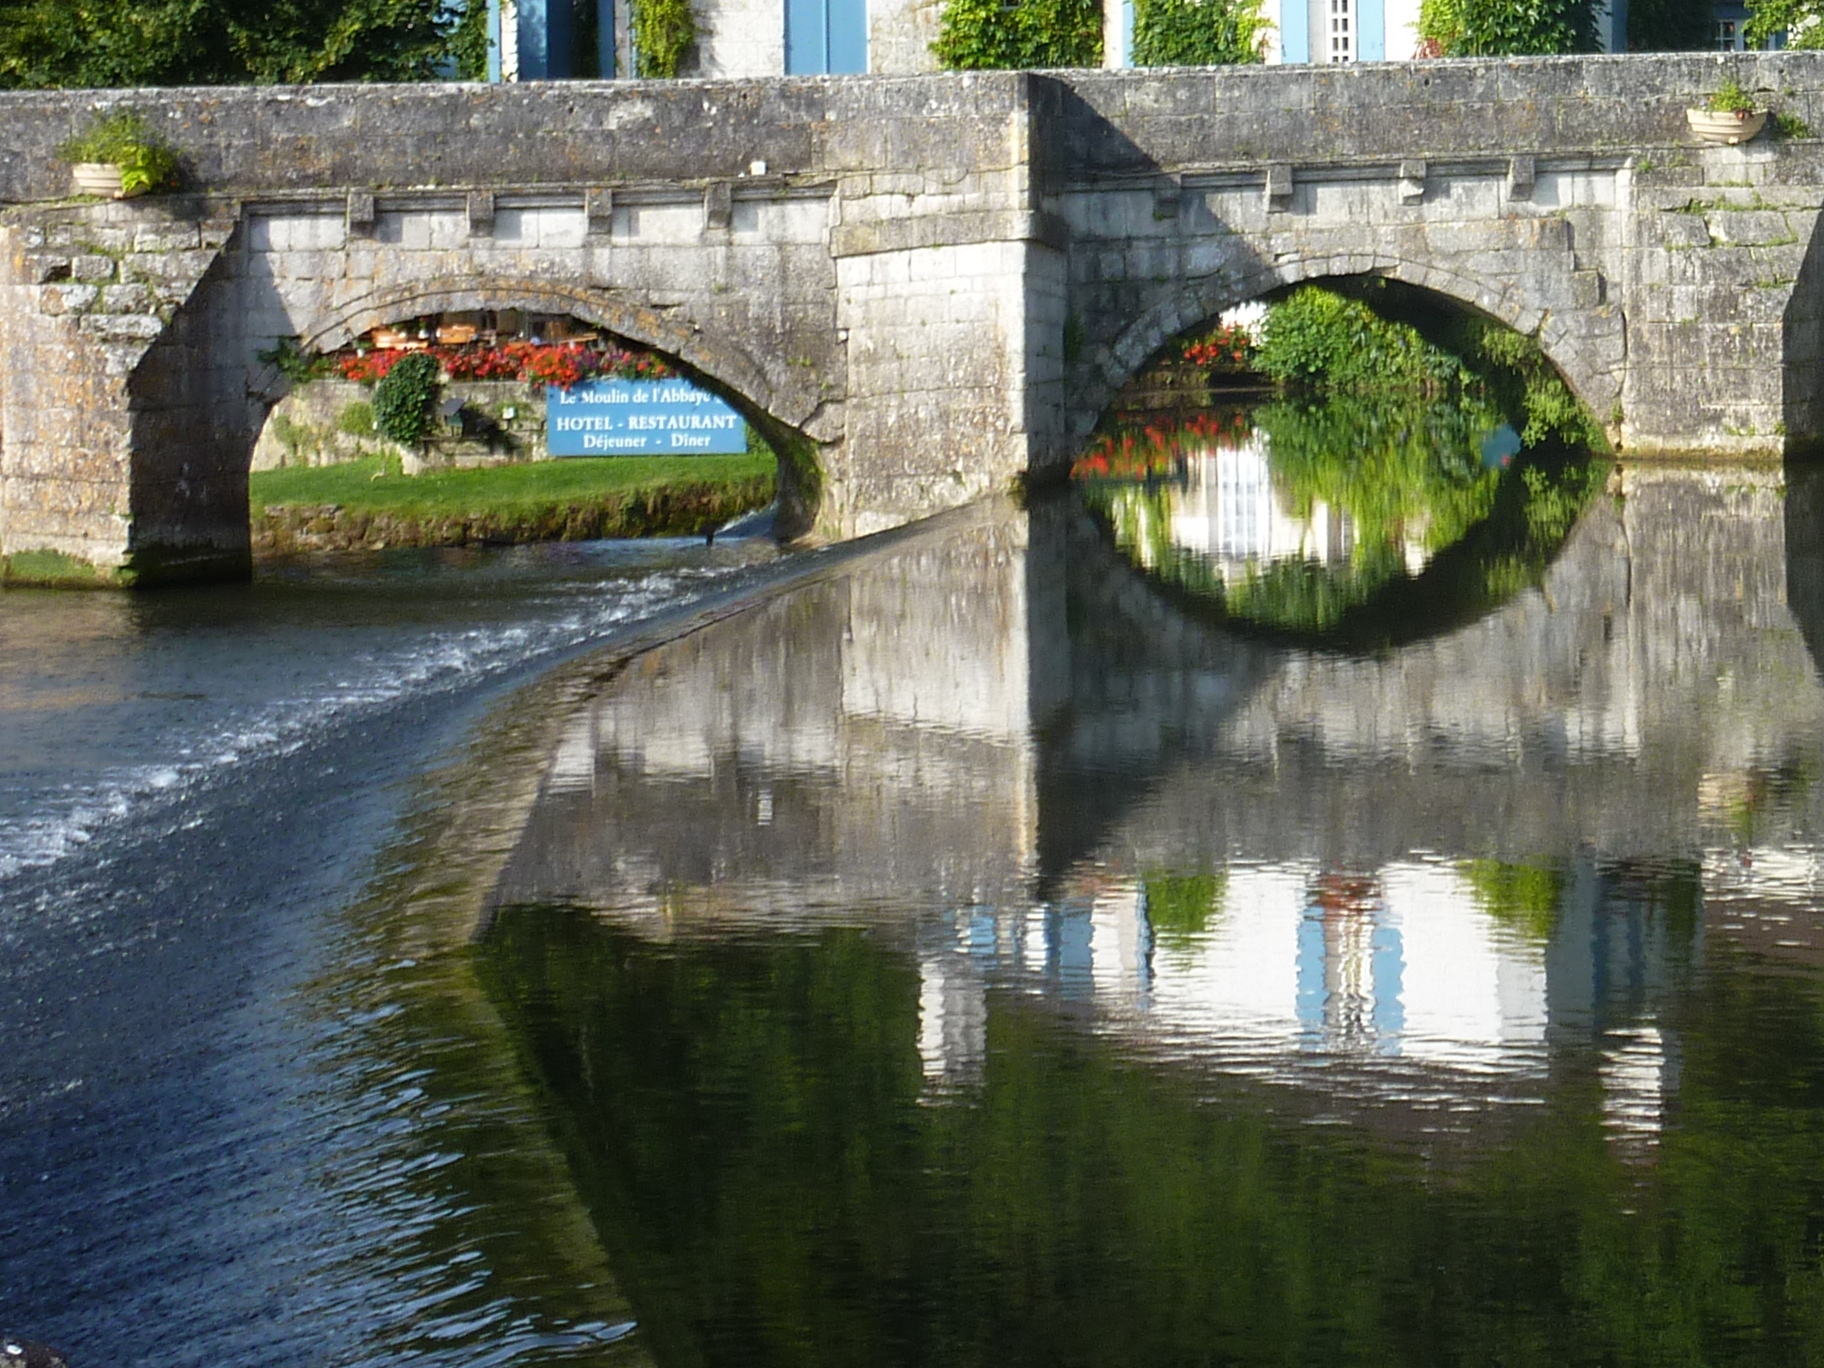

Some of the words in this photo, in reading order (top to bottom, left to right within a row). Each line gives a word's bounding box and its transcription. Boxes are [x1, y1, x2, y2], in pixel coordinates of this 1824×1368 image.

[560, 390, 576, 405] Le
[581, 389, 629, 404] Moulin
[632, 389, 649, 404] de
[652, 387, 710, 406] l'Abbaye
[556, 416, 613, 431] HOTEL
[628, 415, 737, 430] RESTAURANT
[583, 434, 646, 450] Déjeuner
